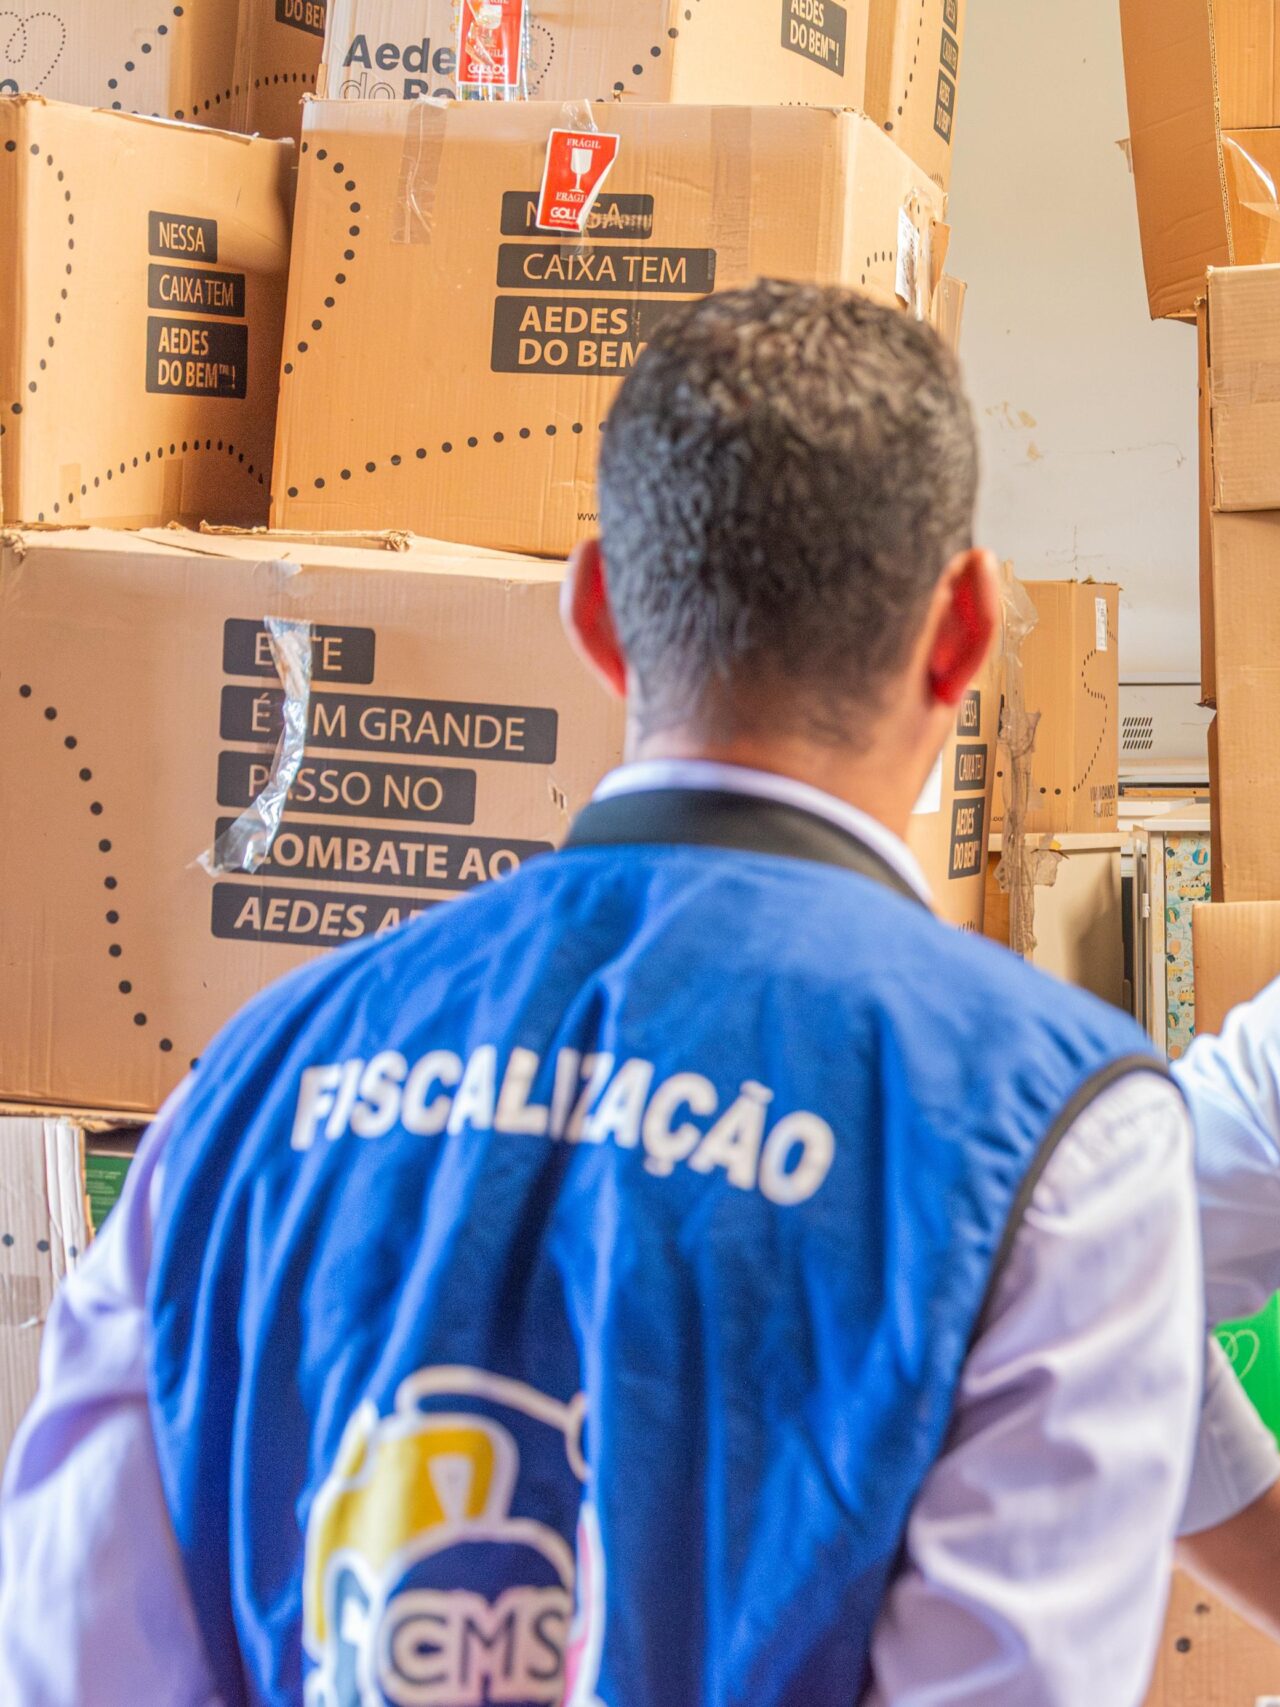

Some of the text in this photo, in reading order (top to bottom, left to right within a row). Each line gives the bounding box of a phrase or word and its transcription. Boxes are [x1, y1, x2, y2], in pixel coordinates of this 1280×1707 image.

[790, 0, 825, 28] AEDES
[789, 19, 808, 49] DO
[342, 34, 456, 76] Aede
[566, 137, 601, 149] FRÁGIL
[525, 201, 624, 229] NSA
[550, 206, 579, 220] GOLL
[158, 221, 206, 253] NESSA
[523, 253, 687, 284] CAIXA TEM
[159, 273, 234, 307] CAIXA TEM
[519, 305, 628, 335] AEDES
[158, 326, 209, 356] AEDES
[518, 338, 569, 366] DO
[157, 358, 183, 387] DO
[255, 632, 343, 671] EE
[251, 692, 271, 732] É
[358, 706, 526, 752] GRANDE
[248, 764, 444, 811] PSSO NO
[263, 832, 521, 882] OMBATE AO
[234, 896, 367, 938] AEDES
[290, 1044, 835, 1206] FISCALIZAÇÃO
